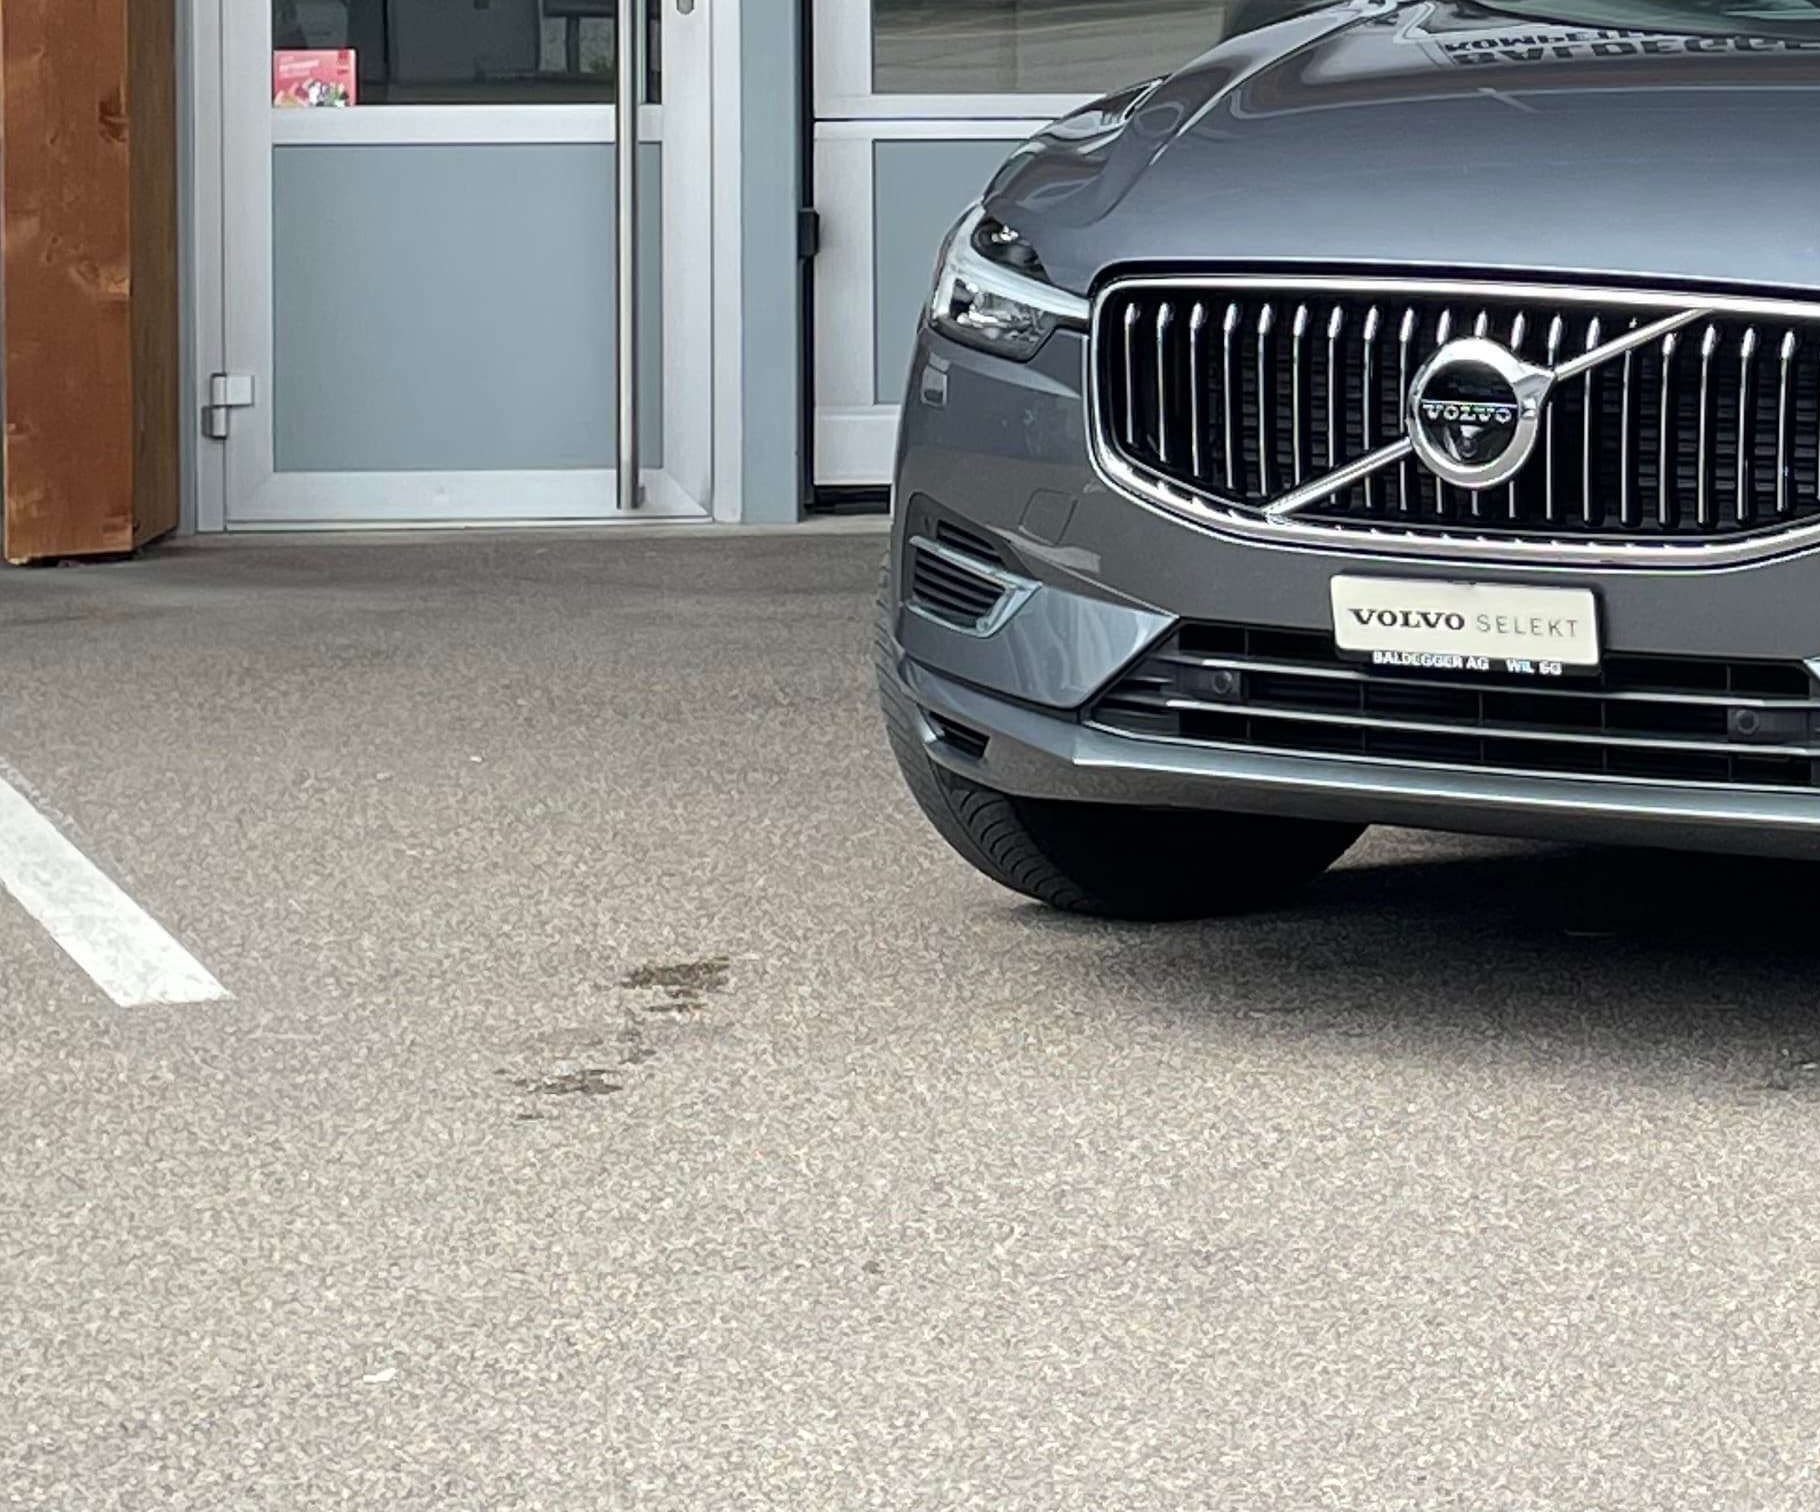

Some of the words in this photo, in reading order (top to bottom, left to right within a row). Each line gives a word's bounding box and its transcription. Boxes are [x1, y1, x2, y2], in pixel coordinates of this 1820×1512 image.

[1422, 404, 1512, 424] VOLVO
[1349, 608, 1465, 631] VOLVO
[1476, 614, 1579, 638] SELEKT
[1466, 655, 1490, 670] AG
